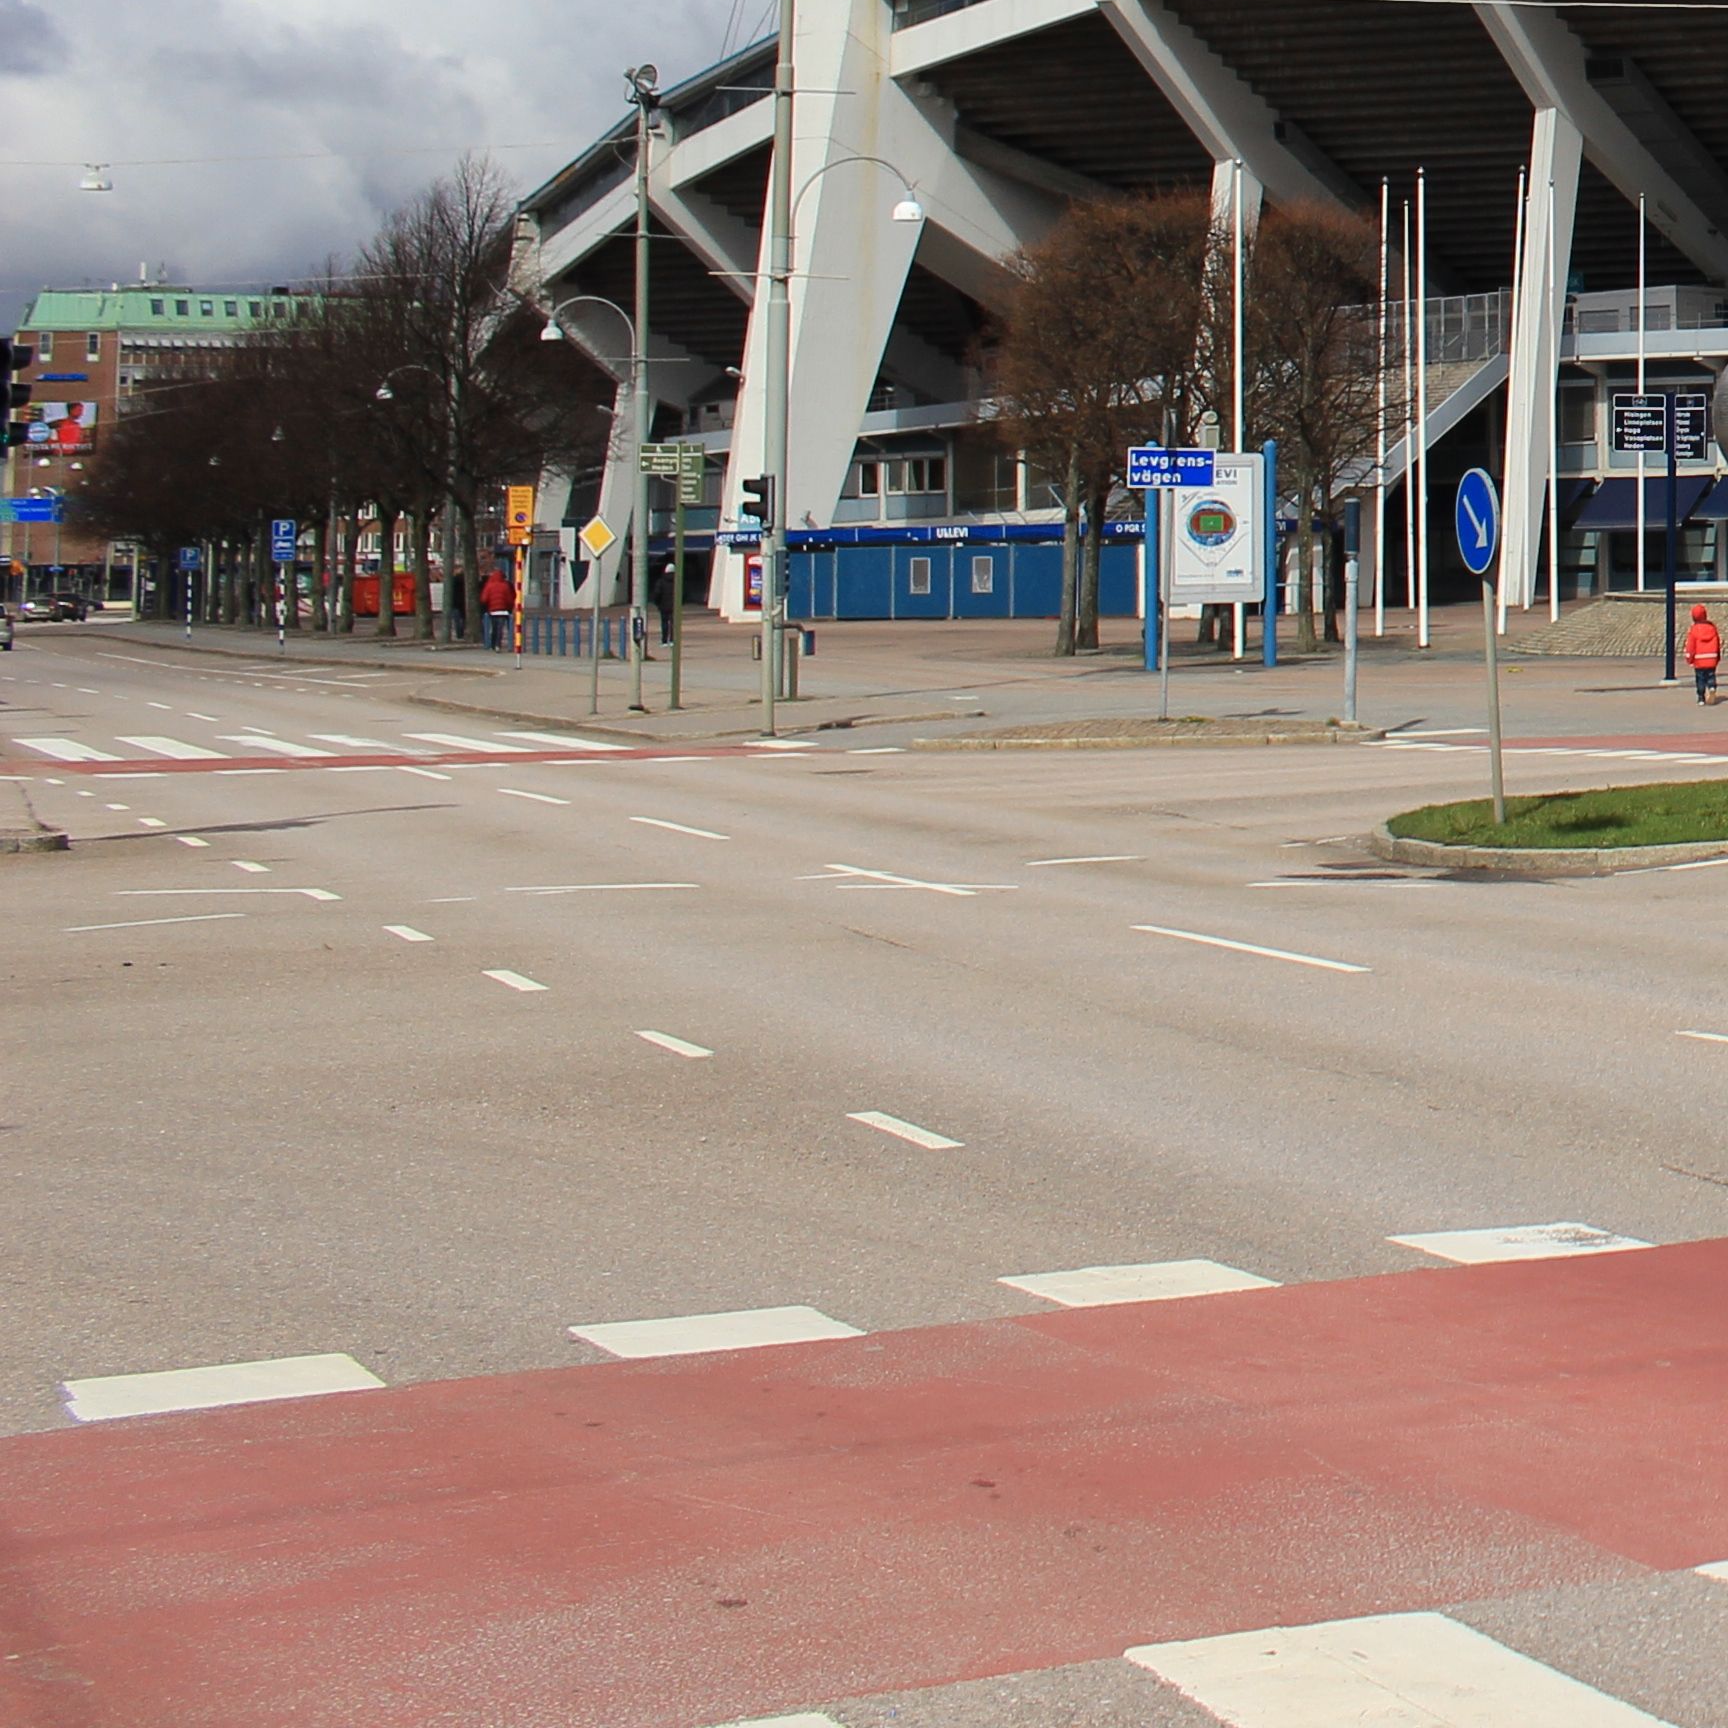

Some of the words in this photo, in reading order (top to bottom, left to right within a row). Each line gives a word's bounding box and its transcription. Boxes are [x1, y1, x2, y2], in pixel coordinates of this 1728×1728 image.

[1131, 453, 1213, 469] Levgrens-
[1131, 470, 1182, 484] vägen
[1215, 469, 1238, 479] EVI
[280, 522, 290, 536] P
[936, 527, 969, 539] ULLEVI
